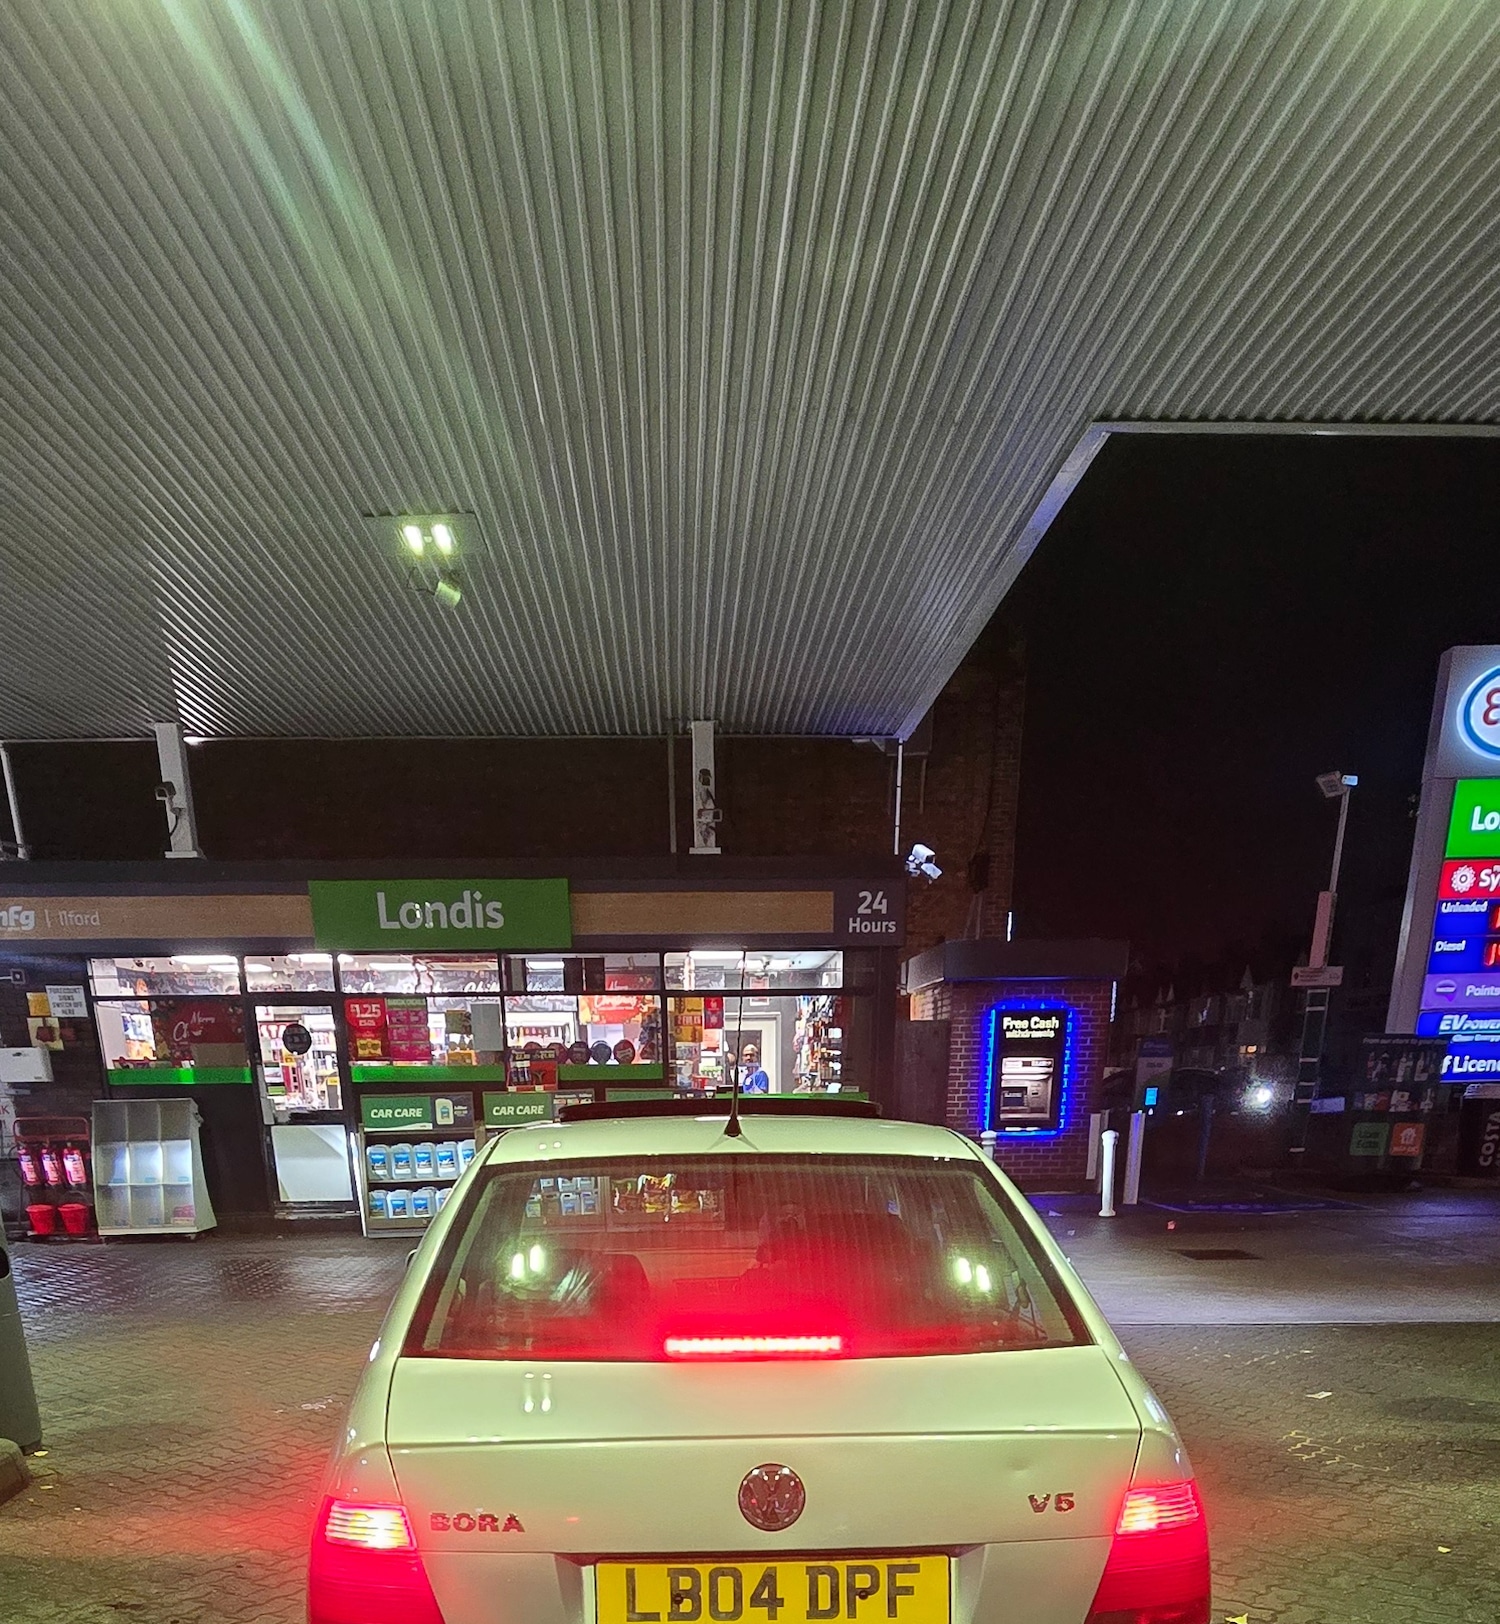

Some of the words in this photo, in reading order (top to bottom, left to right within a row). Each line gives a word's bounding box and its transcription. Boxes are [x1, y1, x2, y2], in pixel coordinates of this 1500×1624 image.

[1471, 806, 1500, 831] Lo
[1479, 868, 1500, 892] Sy
[377, 890, 505, 929] Londis
[857, 891, 887, 914] 24
[1441, 901, 1488, 913] Unleaded
[59, 910, 100, 926] Ilford
[848, 917, 896, 933] Hours
[1434, 940, 1466, 952] Diesel
[1466, 985, 1500, 996] Points
[1003, 1016, 1029, 1029] Free
[1030, 1016, 1059, 1029] Cash
[1453, 1055, 1500, 1074] Licen
[370, 1109, 392, 1118] CAR
[394, 1108, 423, 1118] CARE
[492, 1106, 514, 1115] CAR
[516, 1105, 544, 1115] CARE
[1028, 1492, 1075, 1513] V5
[430, 1512, 525, 1532] BORA
[625, 1566, 785, 1623] LB04
[805, 1564, 921, 1620] DPF
